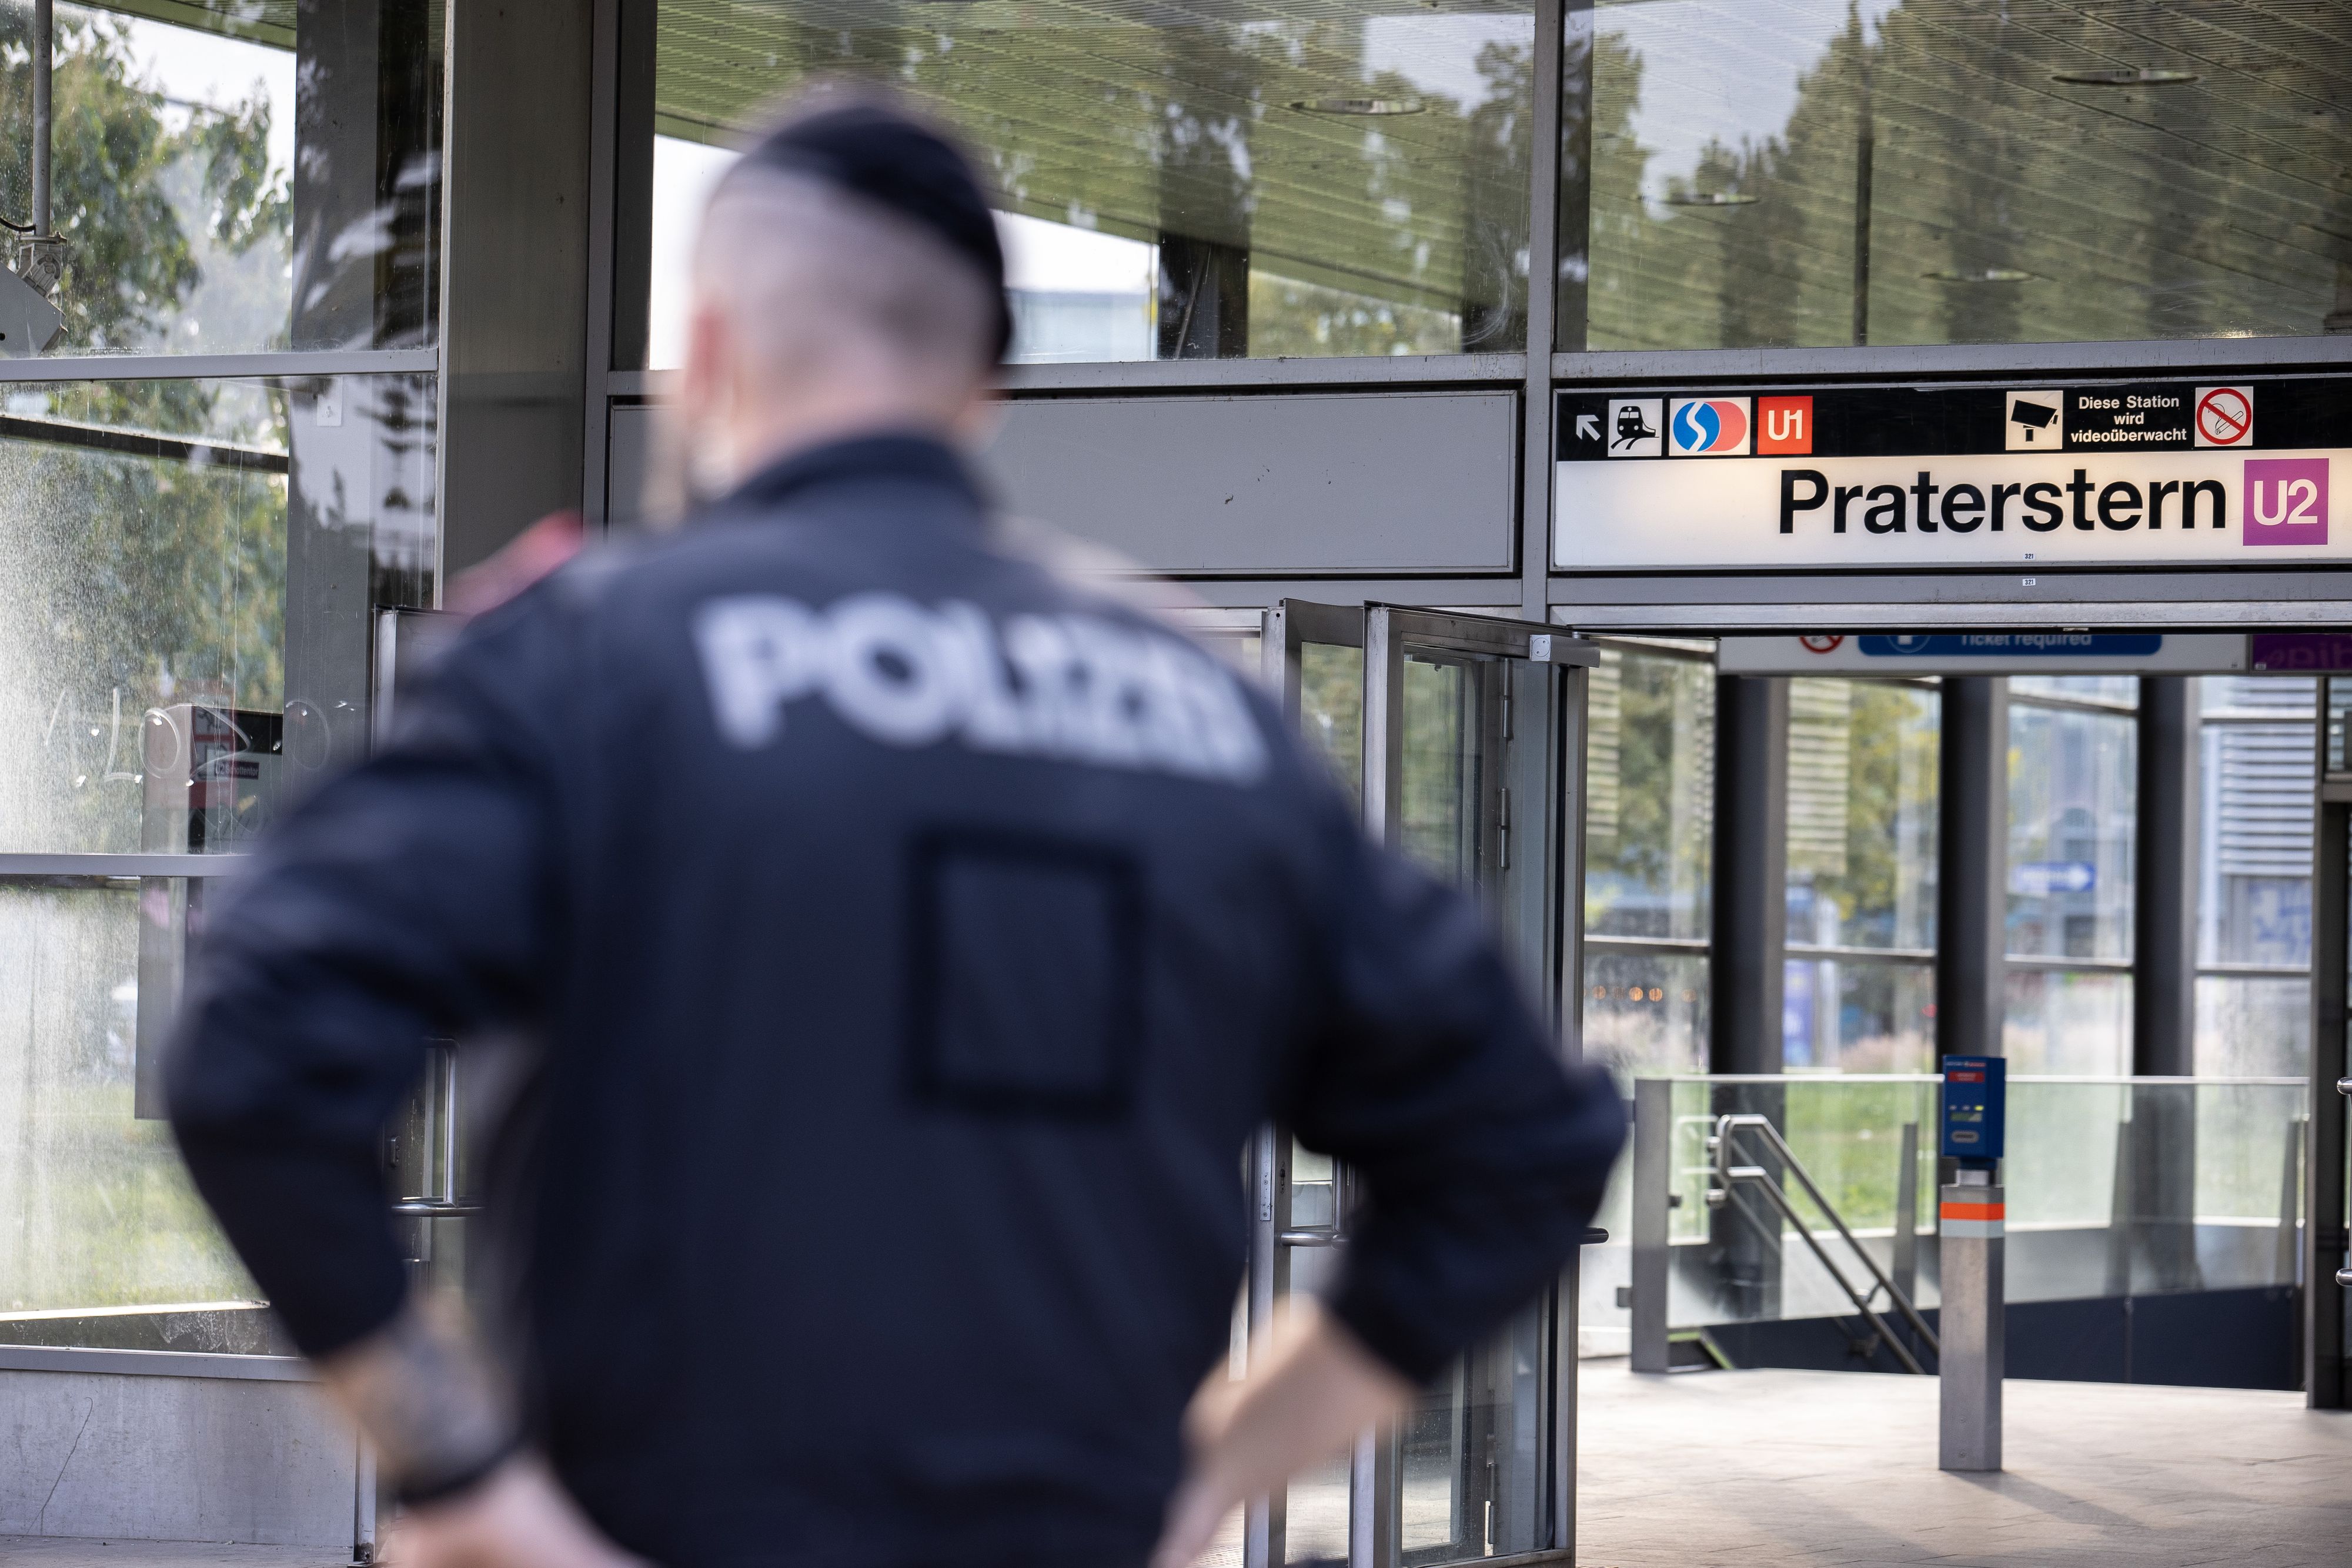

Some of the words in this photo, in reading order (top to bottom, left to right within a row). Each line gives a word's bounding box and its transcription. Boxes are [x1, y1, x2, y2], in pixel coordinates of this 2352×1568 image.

[2079, 396, 2120, 410] Diese
[2126, 395, 2179, 409] Station
[1768, 409, 1803, 441] U1
[2113, 412, 2144, 425] wird
[2070, 427, 2187, 443] videoüberwacht
[1779, 469, 2227, 534] Praterstern
[2253, 479, 2318, 526] U2
